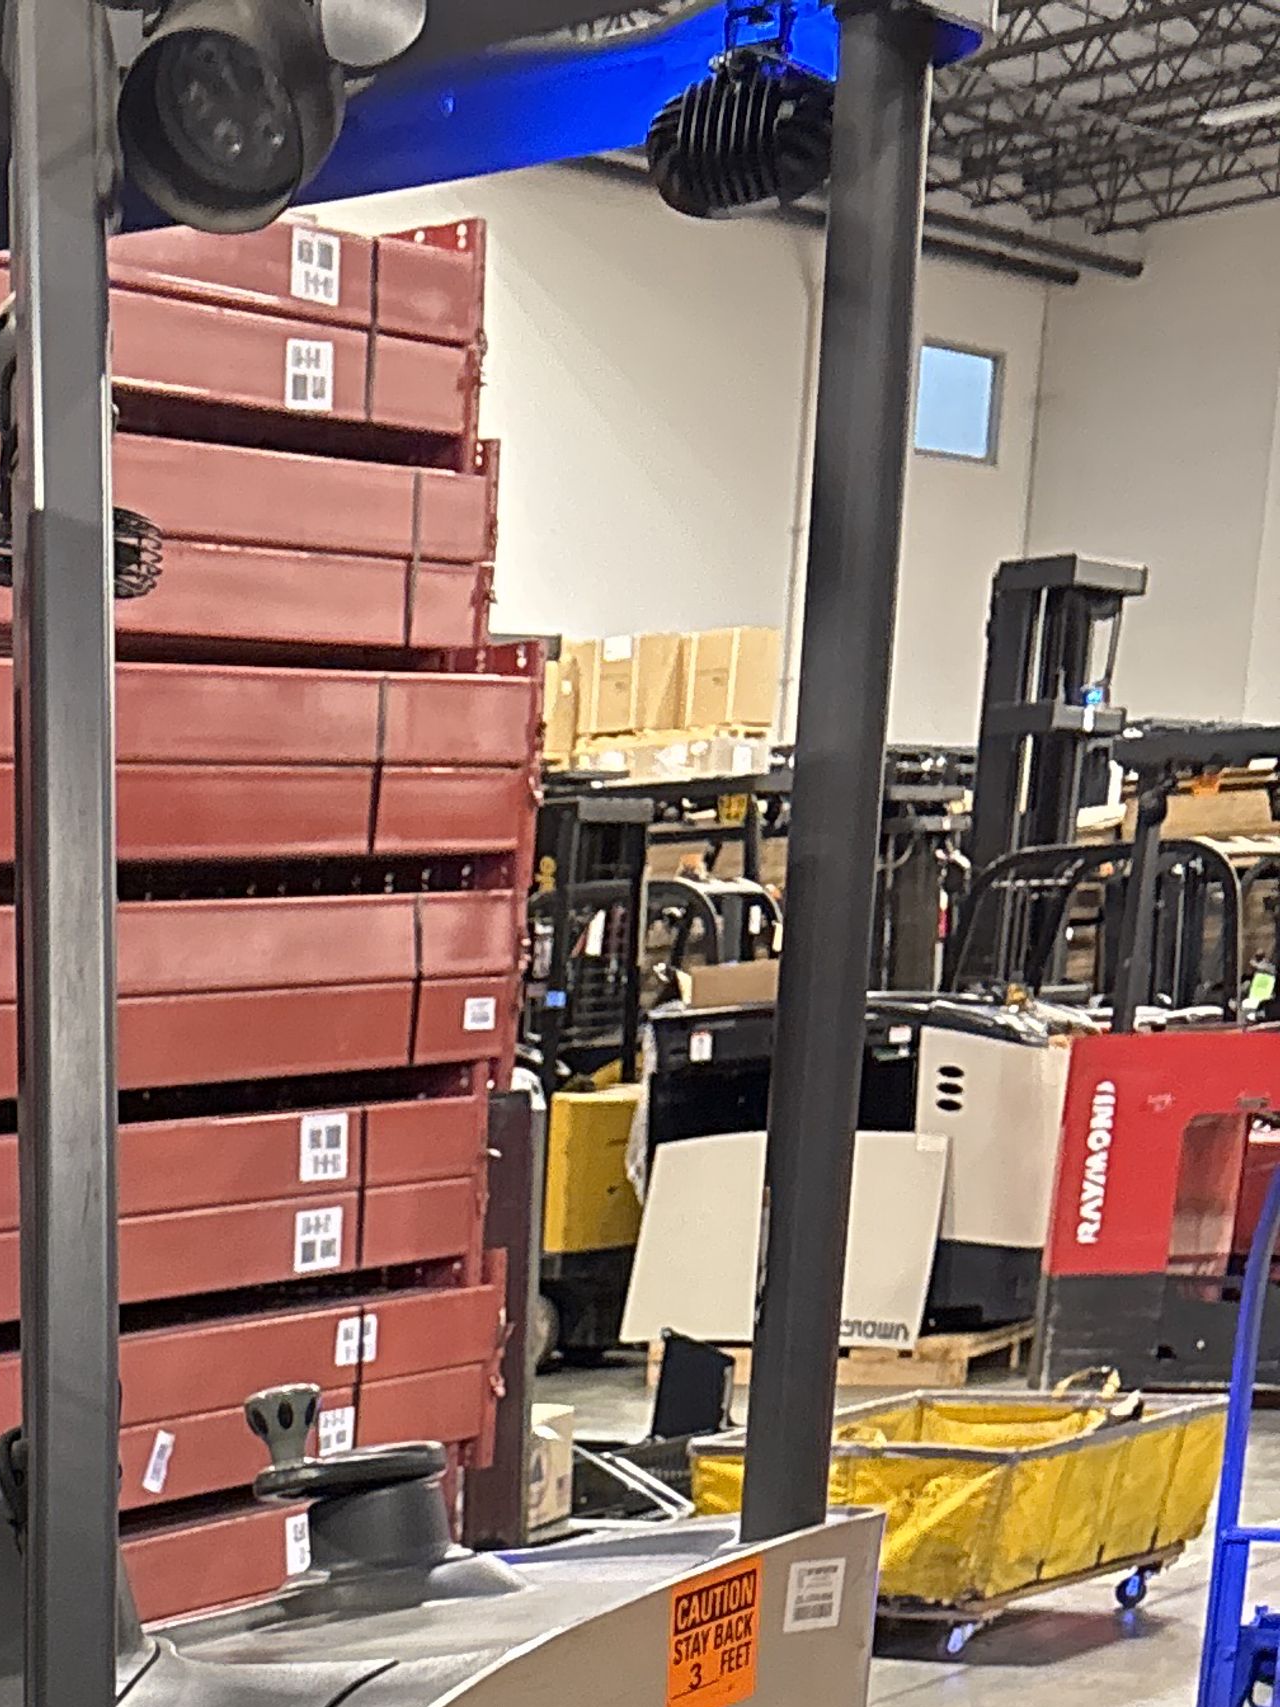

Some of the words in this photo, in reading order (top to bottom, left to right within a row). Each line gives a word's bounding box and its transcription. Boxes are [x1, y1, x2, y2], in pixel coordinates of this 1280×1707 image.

[1076, 1080, 1116, 1244] RAYMOND
[676, 1573, 755, 1632] CAUTION
[673, 1626, 712, 1666] STAY
[714, 1611, 754, 1650] BACK
[689, 1663, 702, 1691] 3
[720, 1641, 751, 1676] FEET
